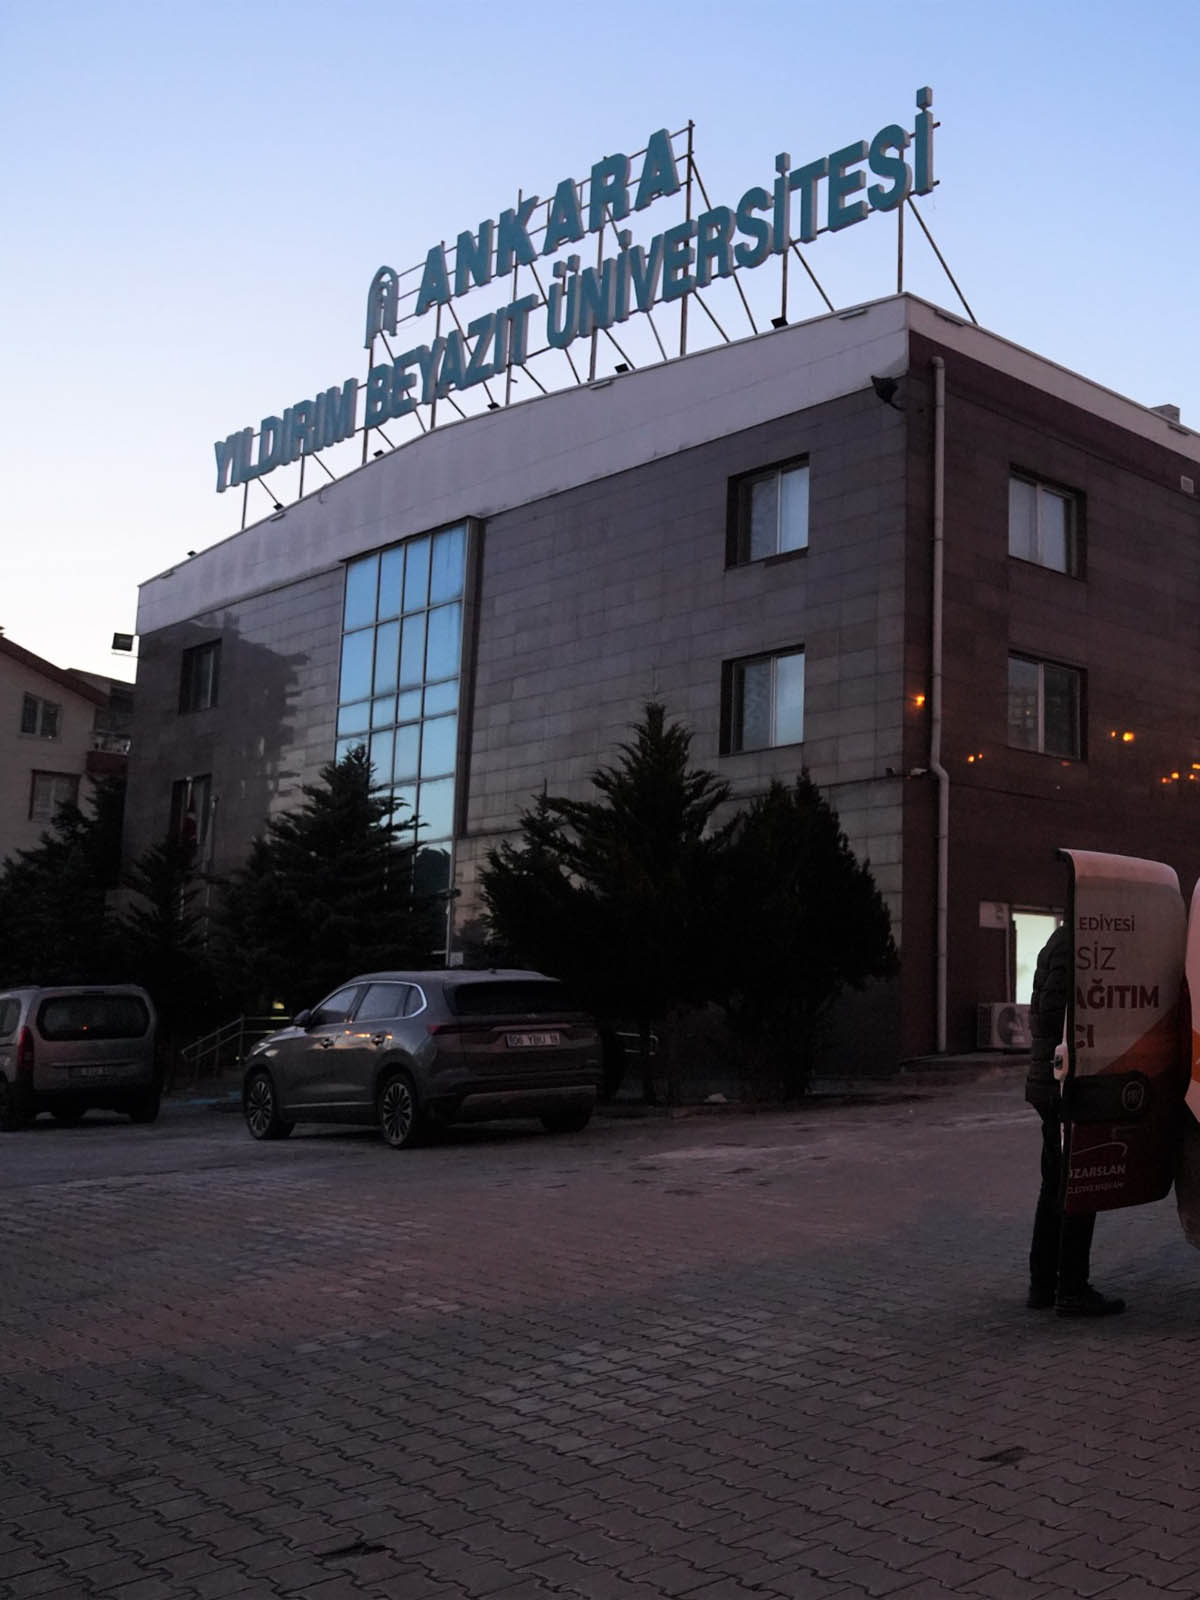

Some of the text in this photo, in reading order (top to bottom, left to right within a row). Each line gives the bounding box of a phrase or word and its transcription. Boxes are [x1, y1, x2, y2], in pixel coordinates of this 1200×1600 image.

[214, 86, 934, 494] YILDIRIM BEYAZIT ÜNİVERSİTESİ
[415, 128, 682, 317] ANKARA
